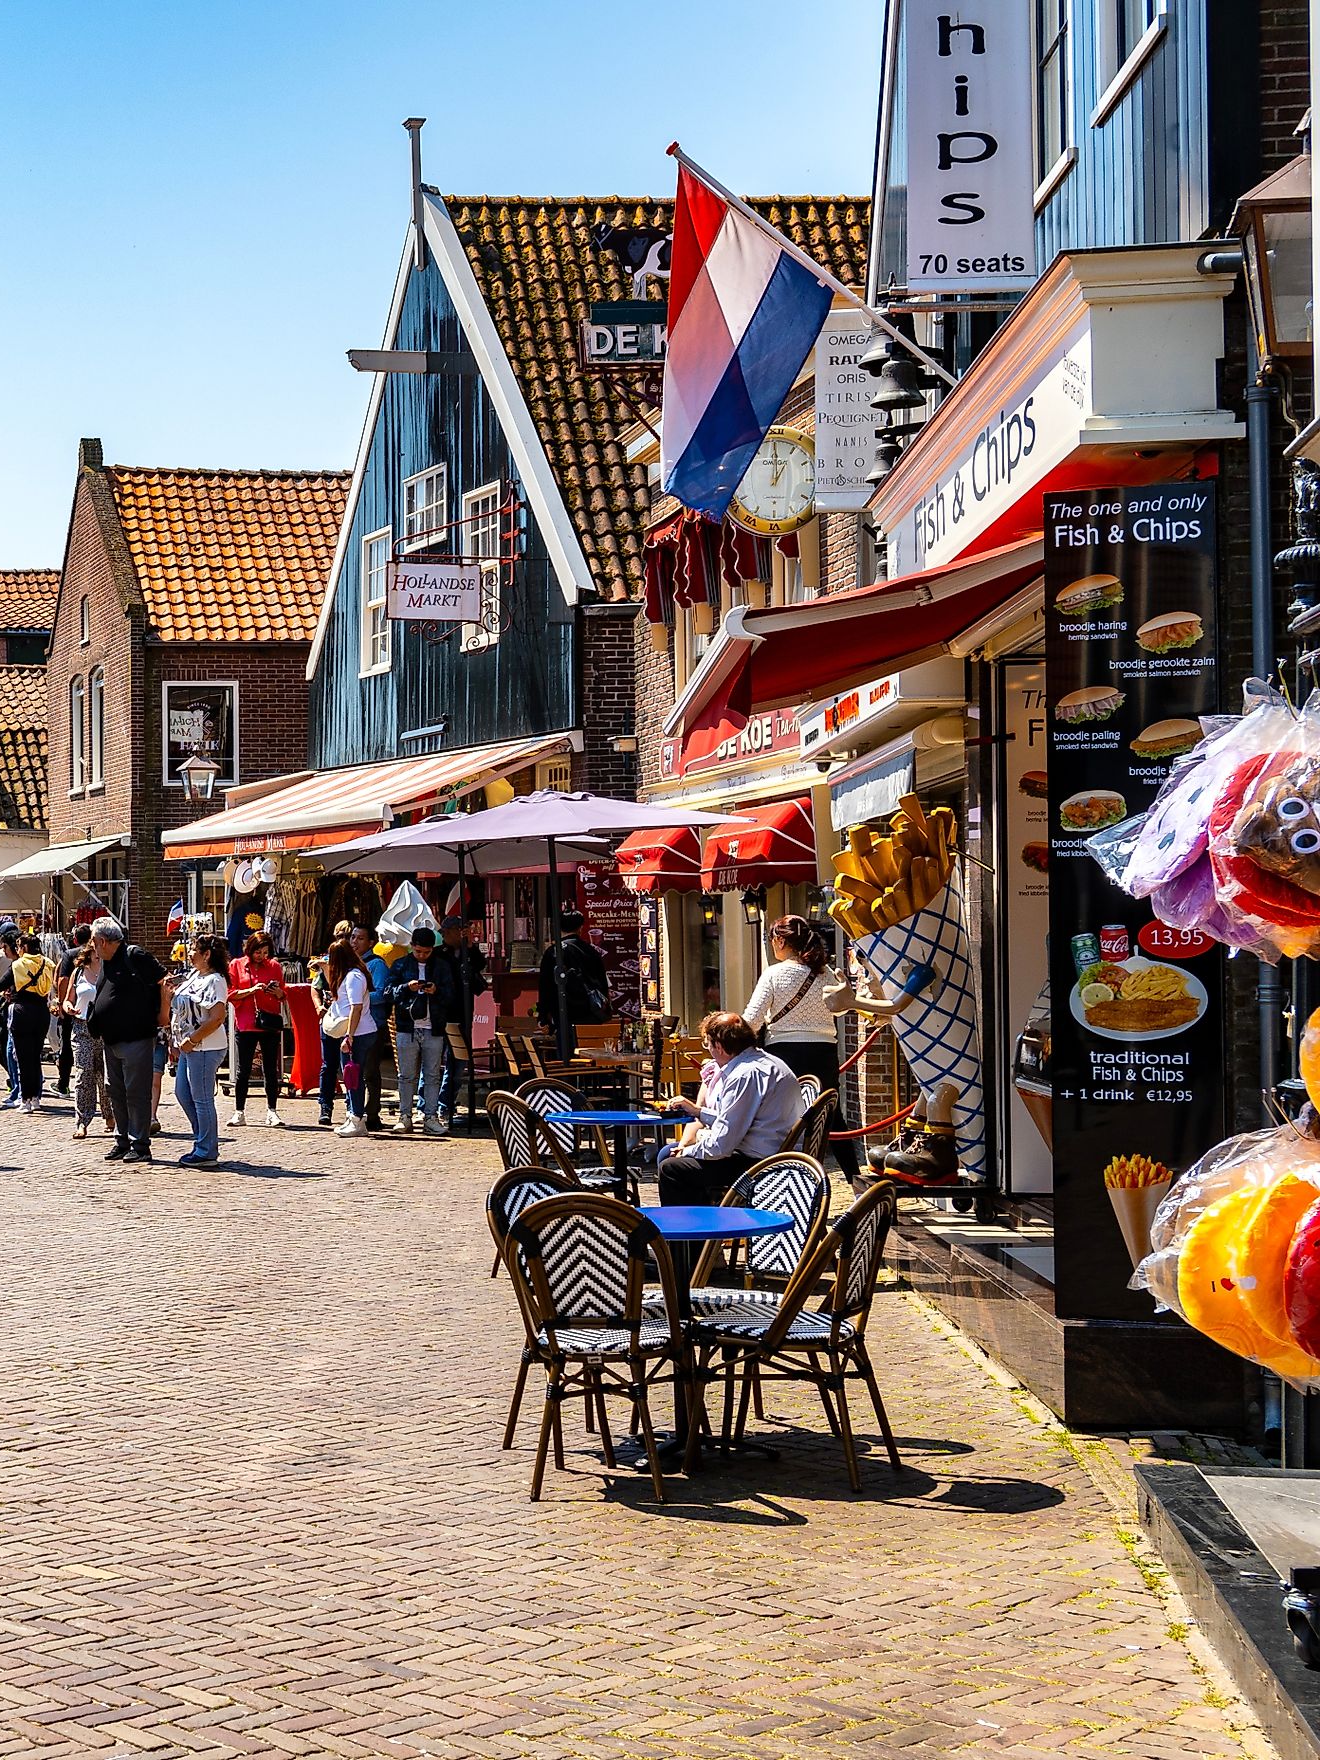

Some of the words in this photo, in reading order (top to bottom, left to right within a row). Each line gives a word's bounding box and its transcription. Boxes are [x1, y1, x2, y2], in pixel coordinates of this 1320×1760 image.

[936, 14, 999, 226] hips
[919, 254, 949, 275] 70
[956, 252, 1026, 274] seats
[591, 325, 638, 355] DE
[829, 354, 864, 366] RAD
[837, 373, 867, 384] ORIS
[826, 391, 878, 403] TIRIS
[818, 412, 887, 428] PEQUIGNET
[913, 482, 946, 564] Fish
[953, 471, 965, 525] &
[971, 397, 1036, 502] Chips
[1050, 503, 1083, 519] The
[1088, 502, 1122, 517] one
[1128, 496, 1164, 514] and
[1167, 493, 1208, 513] only
[1054, 523, 1100, 548] Fish
[1107, 525, 1125, 544] &
[1132, 516, 1202, 543] Chips
[391, 573, 476, 592] HOLLANDSE
[406, 593, 462, 608] MARKT
[1059, 622, 1096, 633] broodje
[1098, 620, 1128, 632] haring
[1090, 632, 1118, 640] sandwich
[1108, 660, 1147, 671] broodje
[1148, 658, 1191, 669] gerookte
[1192, 656, 1215, 667] zalm
[1148, 669, 1172, 677] salmon
[1172, 668, 1201, 676] sandwich
[1021, 690, 1047, 709] Th
[741, 716, 772, 756] KOE
[1028, 718, 1045, 747] F
[1053, 732, 1090, 743] broodje
[1091, 730, 1121, 742] paling
[1055, 743, 1080, 751] smoked
[1091, 742, 1119, 750] sandwich
[1128, 766, 1167, 777] broodje
[584, 899, 613, 910] Special
[613, 899, 633, 908] Price
[1150, 929, 1204, 948] 13,95
[1089, 1051, 1190, 1065] traditional
[1092, 1066, 1121, 1081] Fish
[1125, 1068, 1137, 1082] &
[1141, 1066, 1185, 1084] Chips
[1080, 1088, 1088, 1099] 1
[1092, 1088, 1135, 1101] drink
[1146, 1090, 1193, 1103] €12,95
